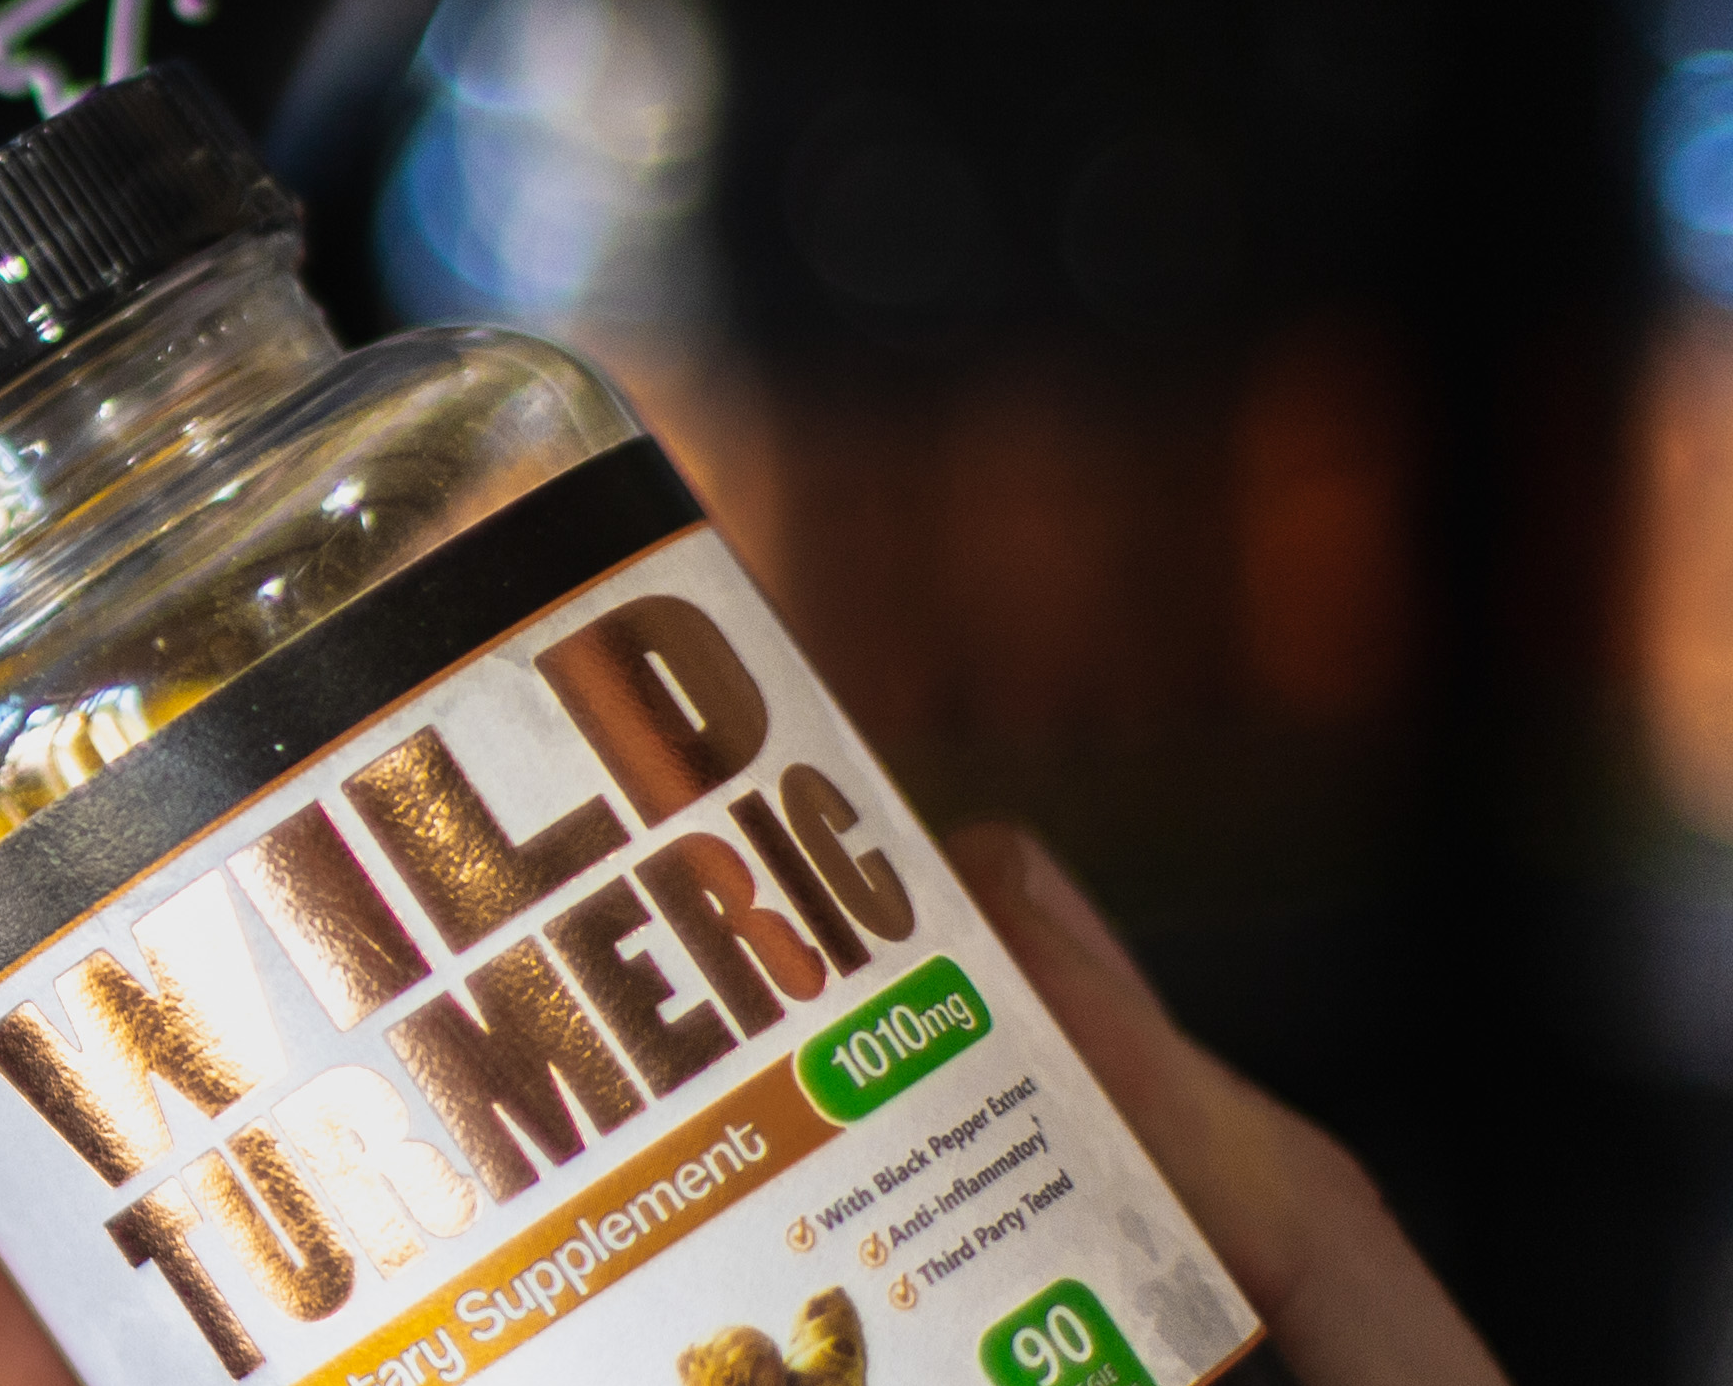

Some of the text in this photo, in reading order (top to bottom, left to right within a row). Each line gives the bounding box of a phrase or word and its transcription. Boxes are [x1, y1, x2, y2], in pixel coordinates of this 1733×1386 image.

[103, 762, 915, 1380] TURMERIC
[831, 991, 974, 1089] 1010mg
[815, 1075, 1037, 1231] With Black Pepper Extract
[916, 1167, 1074, 1285] Third Party Tested
[454, 1120, 769, 1347] Supplement
